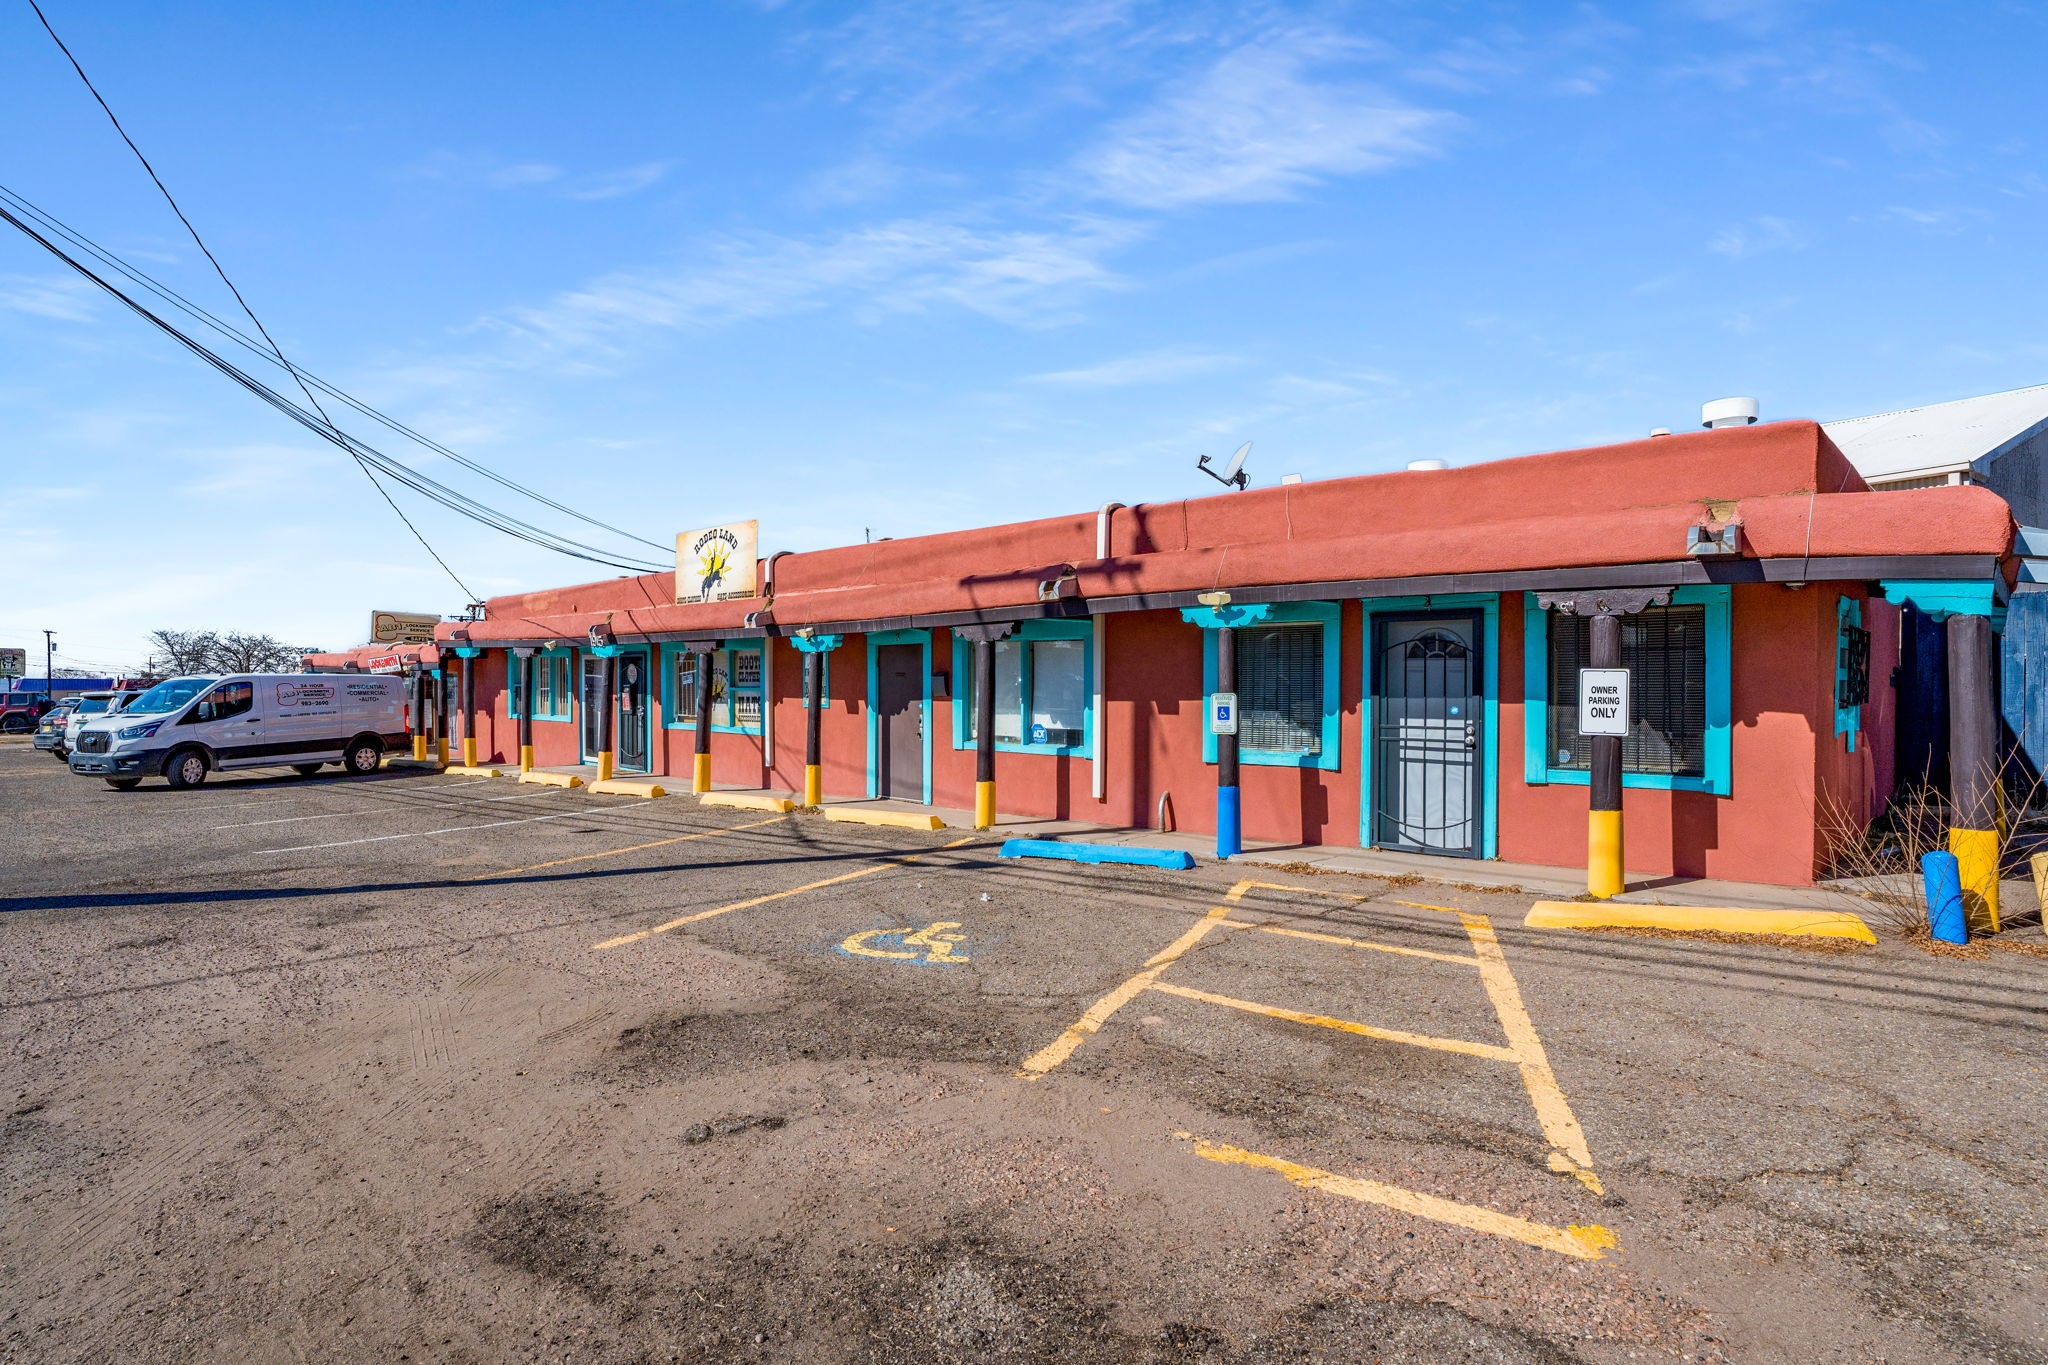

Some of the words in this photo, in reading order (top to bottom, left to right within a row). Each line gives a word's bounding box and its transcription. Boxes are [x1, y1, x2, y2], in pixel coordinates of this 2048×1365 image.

[694, 528, 718, 554] RODEO
[719, 528, 738, 550] LAND
[1591, 686, 1618, 694] OWNER
[1588, 696, 1620, 705] PARKING
[1590, 707, 1617, 718] ONLY
